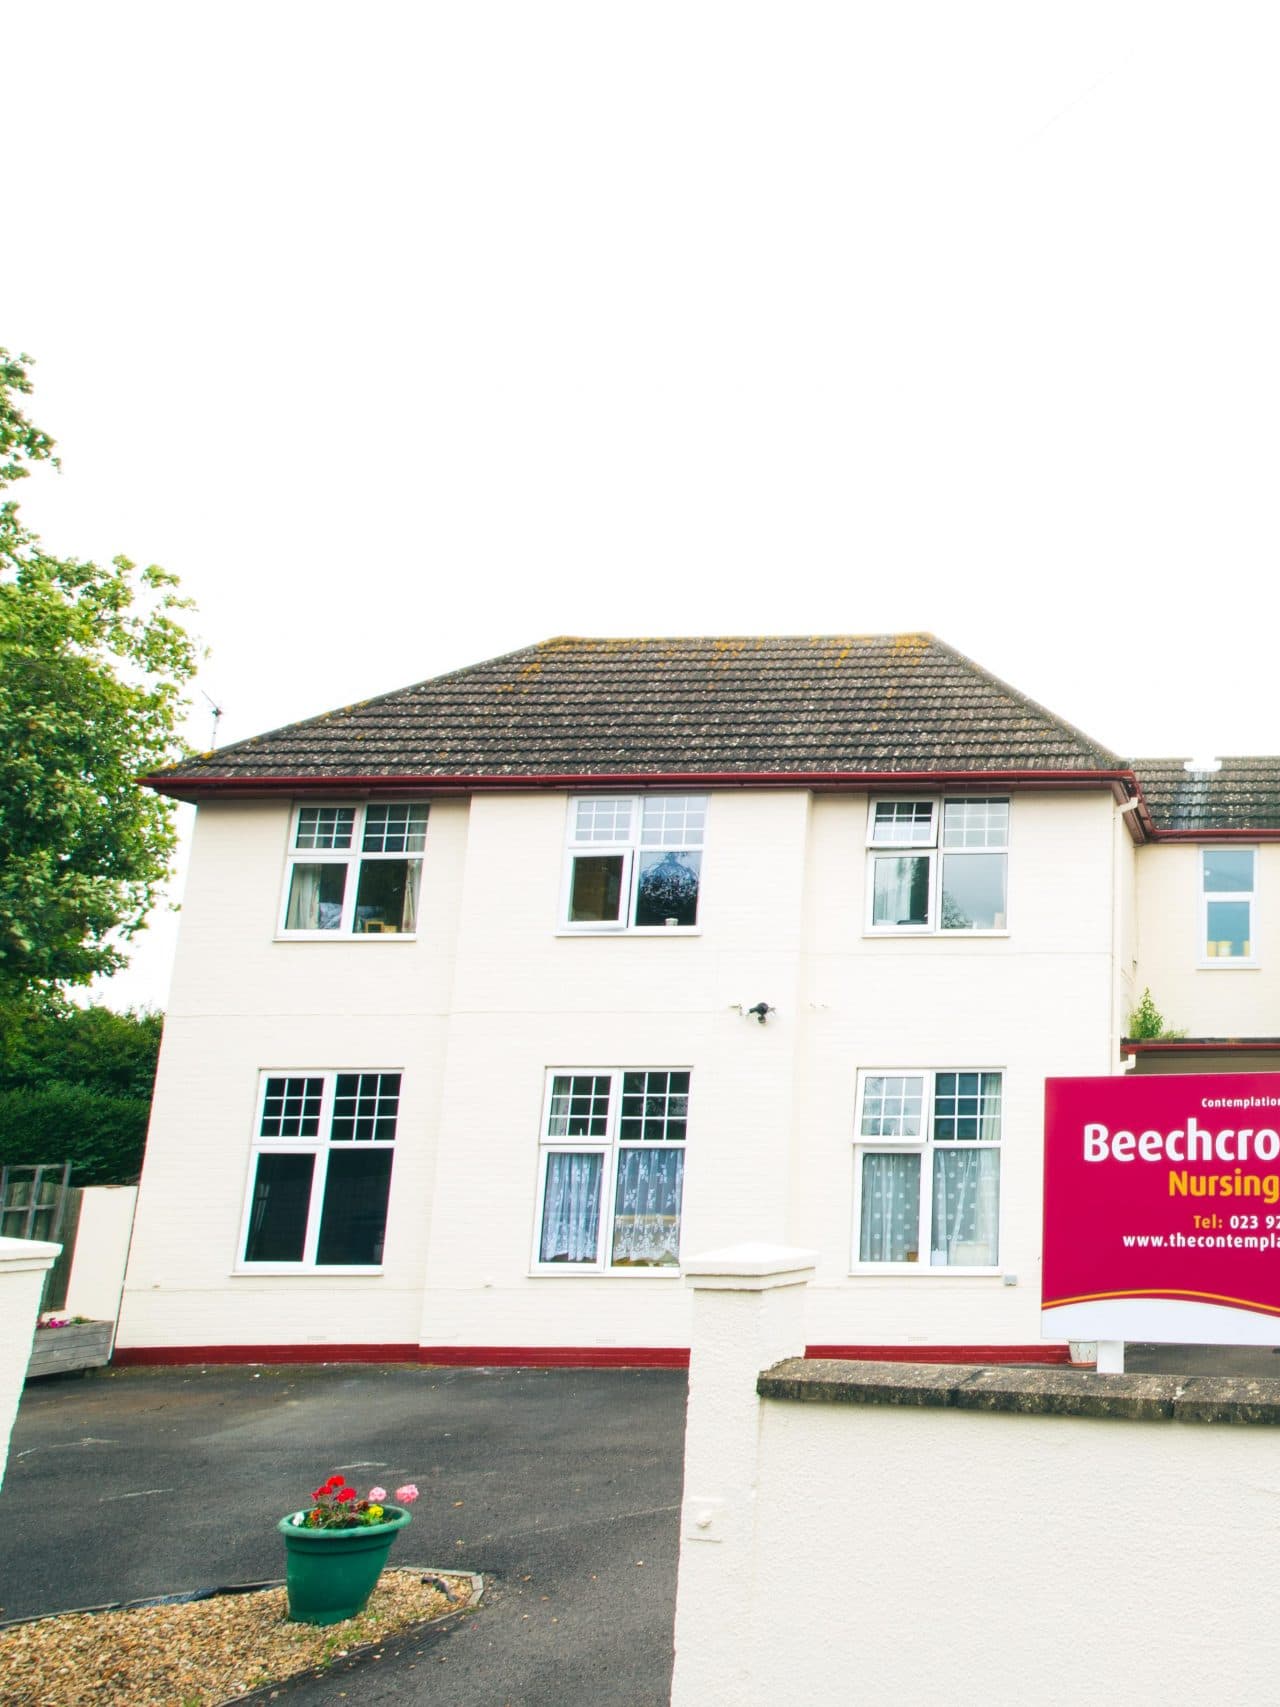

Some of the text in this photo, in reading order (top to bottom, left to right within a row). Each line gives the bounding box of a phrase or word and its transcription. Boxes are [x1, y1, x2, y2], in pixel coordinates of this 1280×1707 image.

[1169, 1167, 1280, 1204] Nursing
[1193, 1214, 1223, 1229] Tel:
[1229, 1215, 1259, 1230] 023
